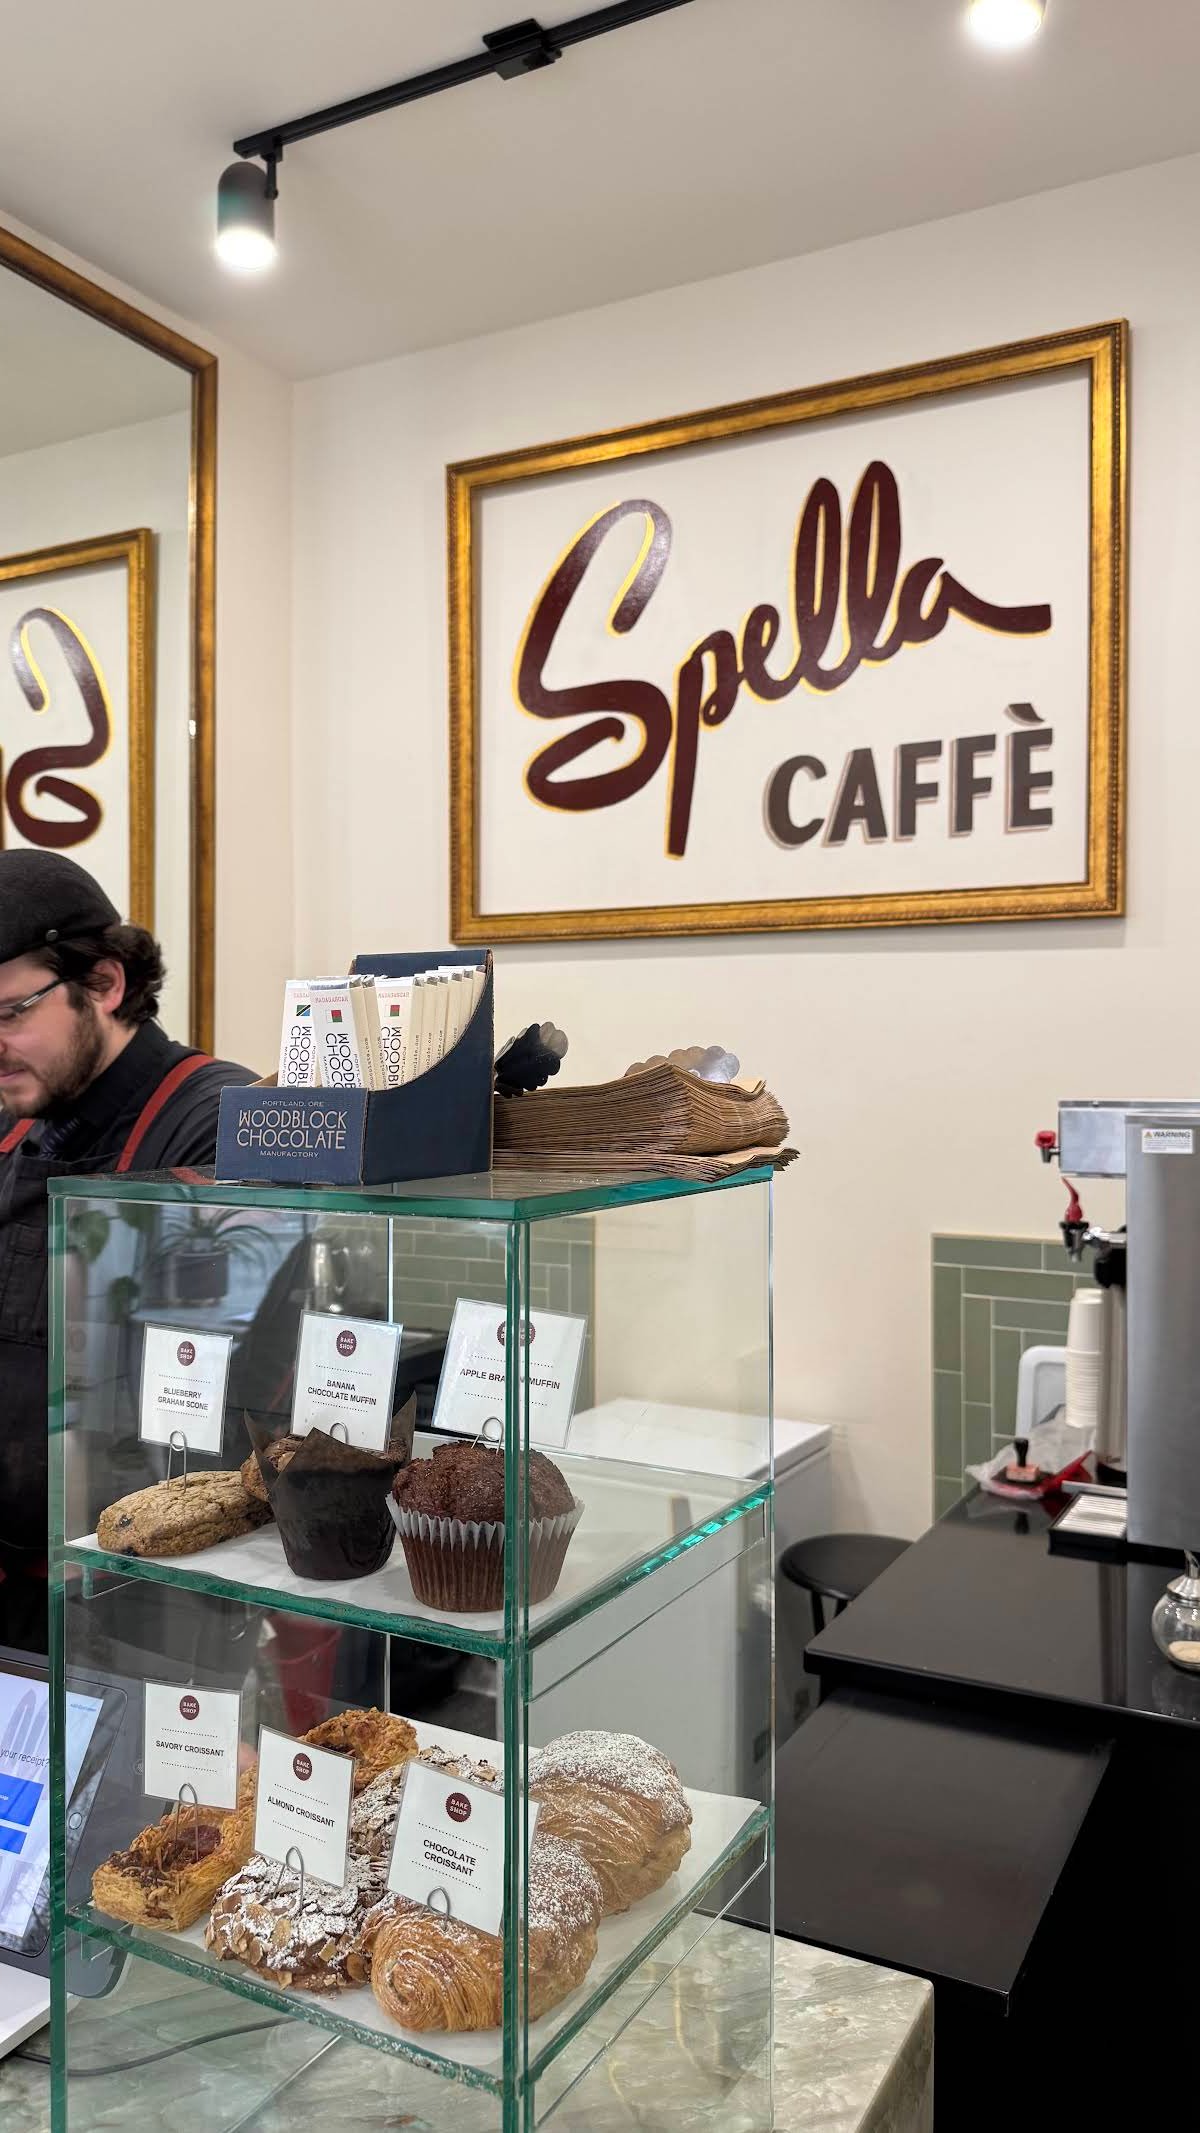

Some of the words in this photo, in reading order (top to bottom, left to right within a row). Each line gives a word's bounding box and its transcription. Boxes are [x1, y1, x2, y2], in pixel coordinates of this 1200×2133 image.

[514, 460, 1052, 859] Spella
[763, 702, 1054, 848] CAFFÈ
[286, 1025, 302, 1087] CHOCO
[297, 1026, 313, 1087] WOODBL
[336, 1033, 357, 1088] WOODB
[238, 1109, 348, 1129] WOODBLOCK
[236, 1128, 347, 1150] CHOCOLATE
[259, 1150, 320, 1158] MANUFACTORY
[340, 1336, 354, 1344] BAKE
[459, 1368, 487, 1381] APPLE
[163, 1387, 202, 1399] BLUEBERRY
[326, 1379, 356, 1391] BANANA
[157, 1396, 185, 1407] GRAHAM
[185, 1400, 209, 1411] SCONE
[307, 1386, 349, 1400] CHOCOLATE
[350, 1394, 377, 1406] MUFFIN
[155, 1740, 183, 1751] SAVORY
[184, 1745, 225, 1757] CROISSANT
[267, 1795, 295, 1812] ALMOND
[295, 1807, 336, 1828] CROISSANT
[449, 1805, 468, 1817] SHOP
[450, 1798, 469, 1810] BAKE
[423, 1839, 477, 1866] CHOCOLATE
[424, 1851, 474, 1877] CROISSANT
